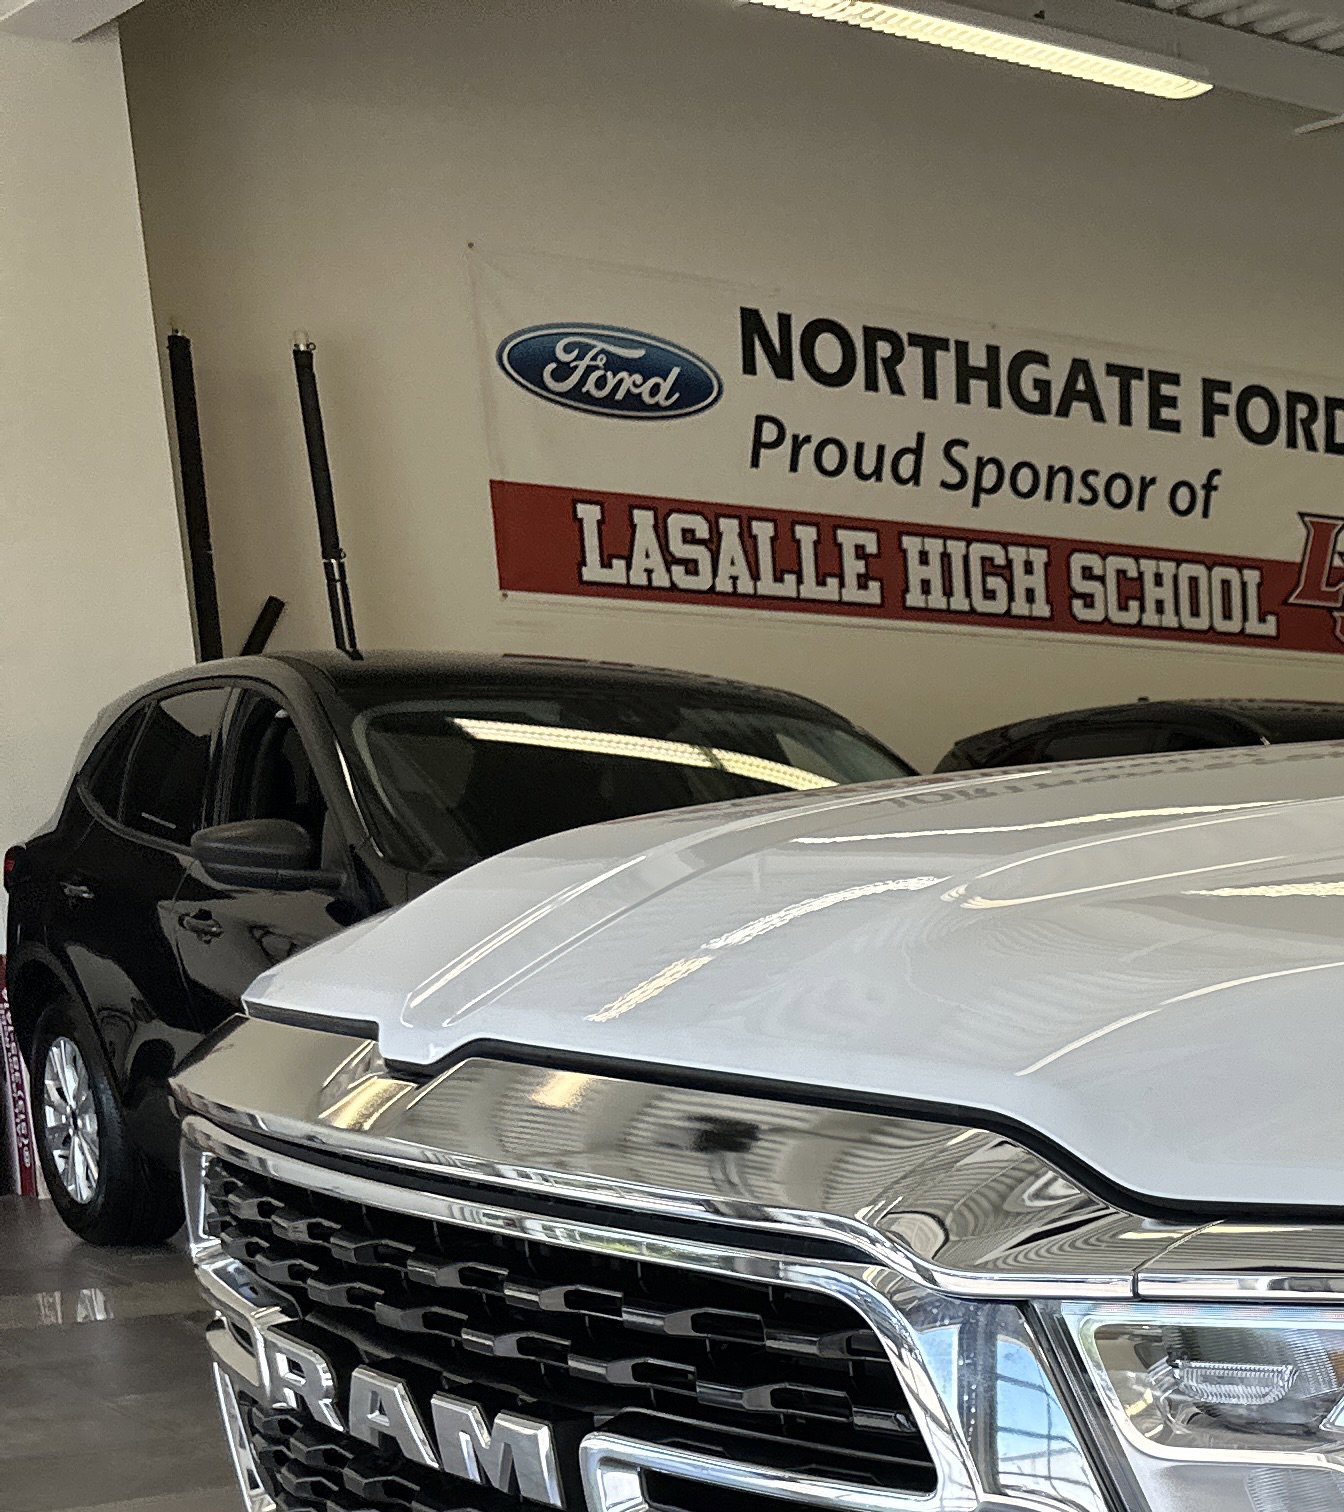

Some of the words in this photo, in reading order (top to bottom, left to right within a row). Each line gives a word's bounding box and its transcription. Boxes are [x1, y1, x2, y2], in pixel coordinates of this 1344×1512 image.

[543, 335, 680, 413] Ford
[739, 306, 1182, 433] NORTHGATE
[750, 414, 925, 488] Proud
[940, 438, 1158, 510] Sponsor
[1167, 469, 1221, 519] of
[575, 502, 882, 606] LASALLE
[902, 535, 1052, 619] HIGH
[1069, 550, 1278, 636] SCHOOL
[267, 1323, 564, 1509] RAM
